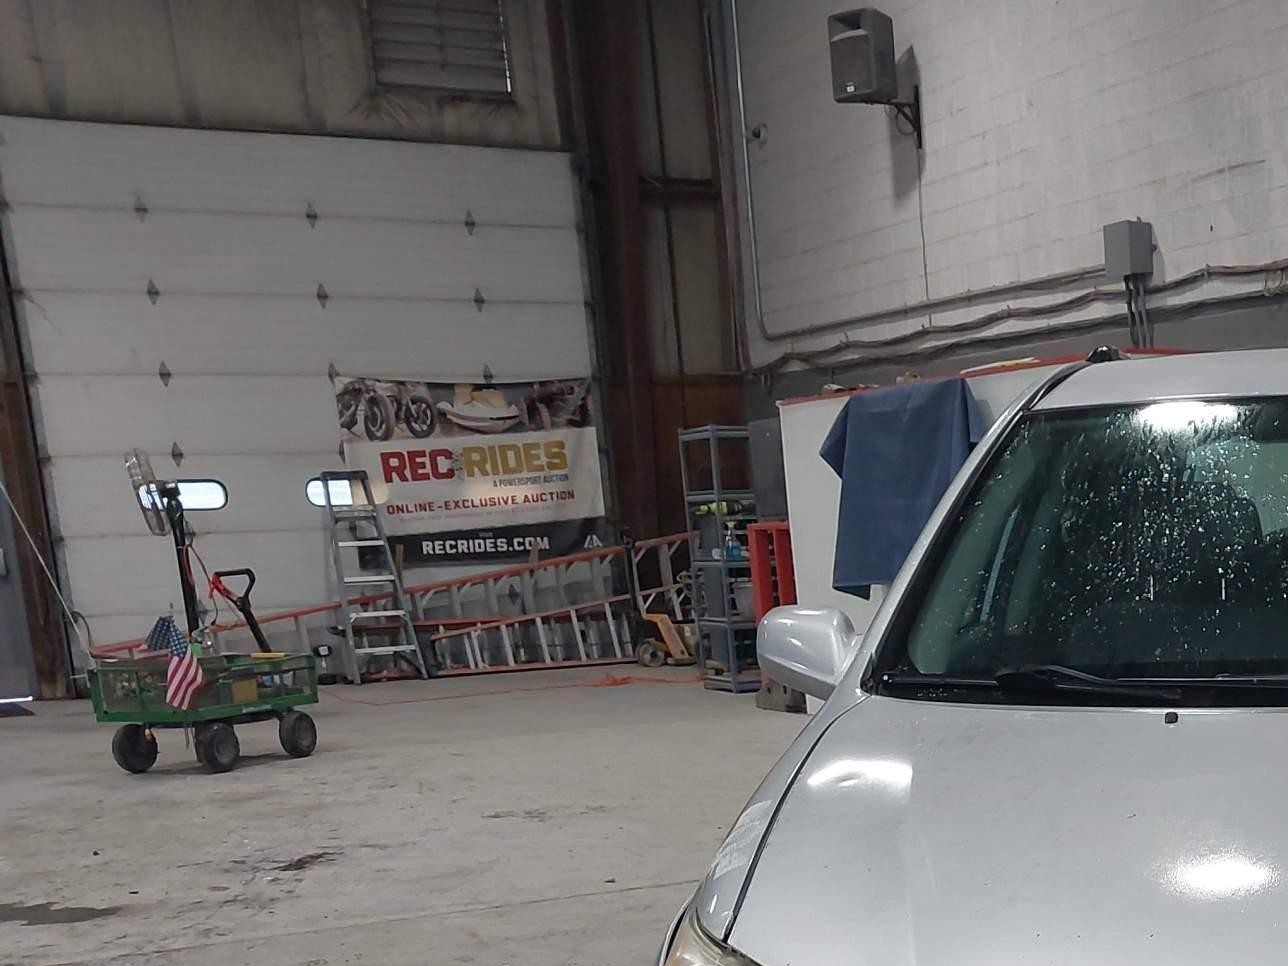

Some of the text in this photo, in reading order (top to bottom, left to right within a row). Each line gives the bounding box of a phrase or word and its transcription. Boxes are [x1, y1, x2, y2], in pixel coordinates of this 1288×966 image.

[380, 440, 569, 484] REC RIDES
[386, 494, 519, 515] ONLINE-EXCLUSIVE
[522, 489, 576, 504] AUCTION
[422, 536, 550, 555] RECRIDES.COM
